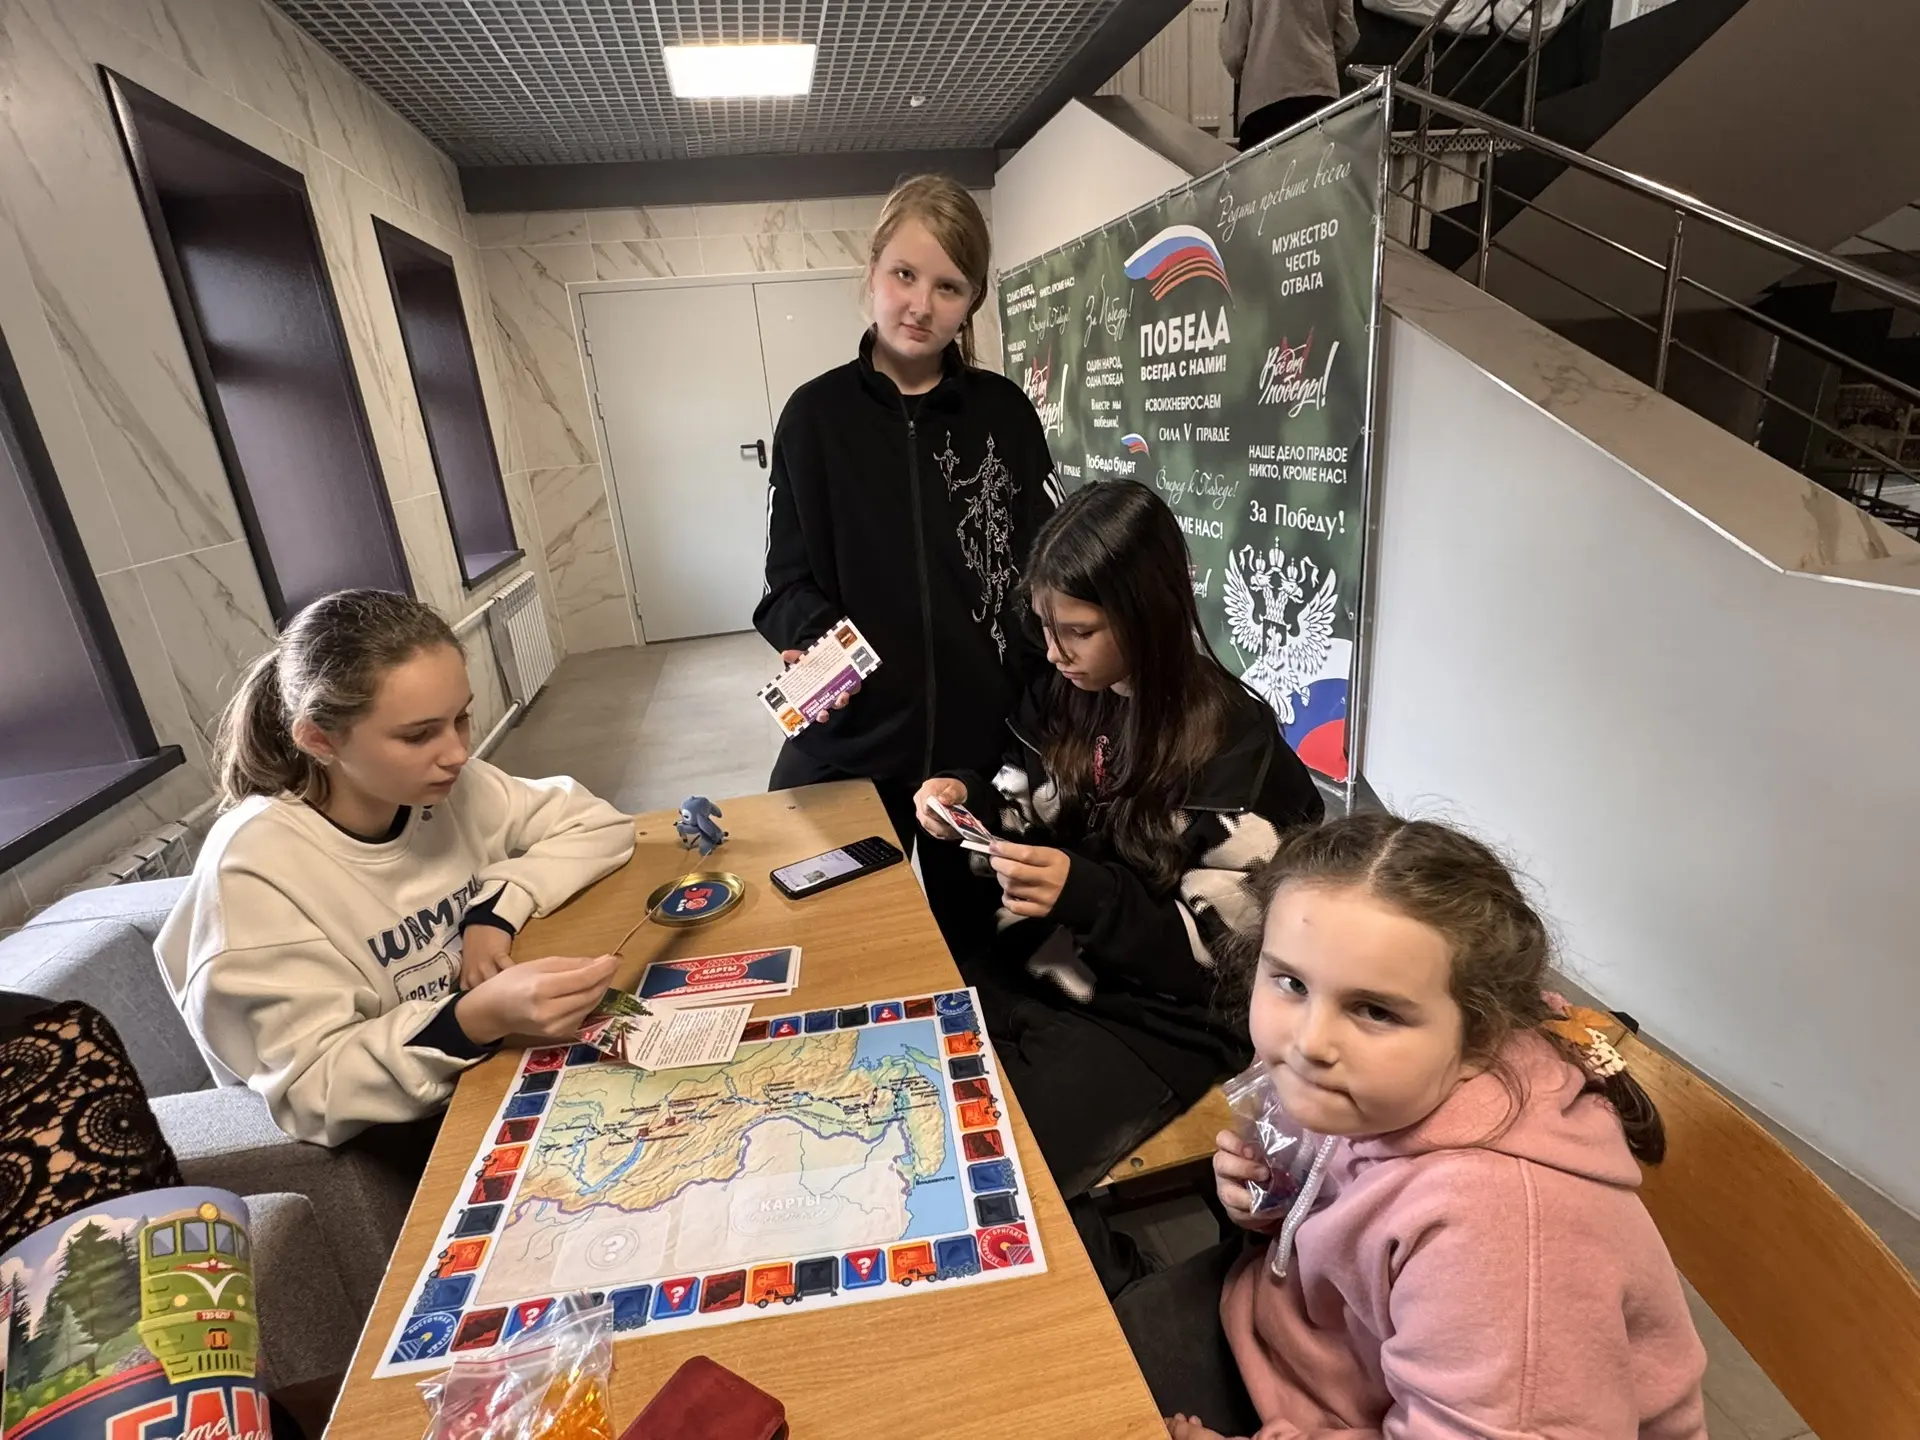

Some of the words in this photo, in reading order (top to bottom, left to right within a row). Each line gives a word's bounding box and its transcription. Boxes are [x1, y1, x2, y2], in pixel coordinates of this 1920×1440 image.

[1272, 218, 1339, 255] МУЖЕСТВО
[1285, 249, 1321, 273] ЧЕСТЬ
[1280, 271, 1324, 297] ОТВАГА
[1140, 305, 1231, 358] ПОБЕДА
[1140, 361, 1177, 382] ВСЕГДА
[1179, 360, 1187, 377] С
[1189, 354, 1227, 376] НАМИ!
[1101, 372, 1124, 387] ПОБЕДА
[1258, 341, 1340, 418] победы!
[1145, 393, 1221, 412] #СВОИХНЕБРОСАЕМ
[1159, 427, 1180, 441] СИЛА
[1183, 422, 1192, 441] V
[1196, 427, 1230, 442] ПРАВДЕ
[1085, 454, 1113, 473] Победа
[1113, 456, 1136, 475] будет
[1248, 445, 1276, 459] НАШЕ
[1276, 445, 1305, 462] ДЕЛО
[1306, 446, 1348, 463] ПРАВОЕ
[1248, 463, 1281, 481] НИКТО,
[1282, 465, 1317, 482] КРОМЕ
[1318, 467, 1348, 484] НАС!
[1195, 518, 1223, 540] НАС!
[1249, 500, 1268, 523] За
[1275, 503, 1346, 541] Победу!
[702, 965, 738, 974] КАРТЫ
[760, 1194, 821, 1212] КАРТЫ
[857, 1256, 872, 1275] ?
[670, 1286, 685, 1304] ?
